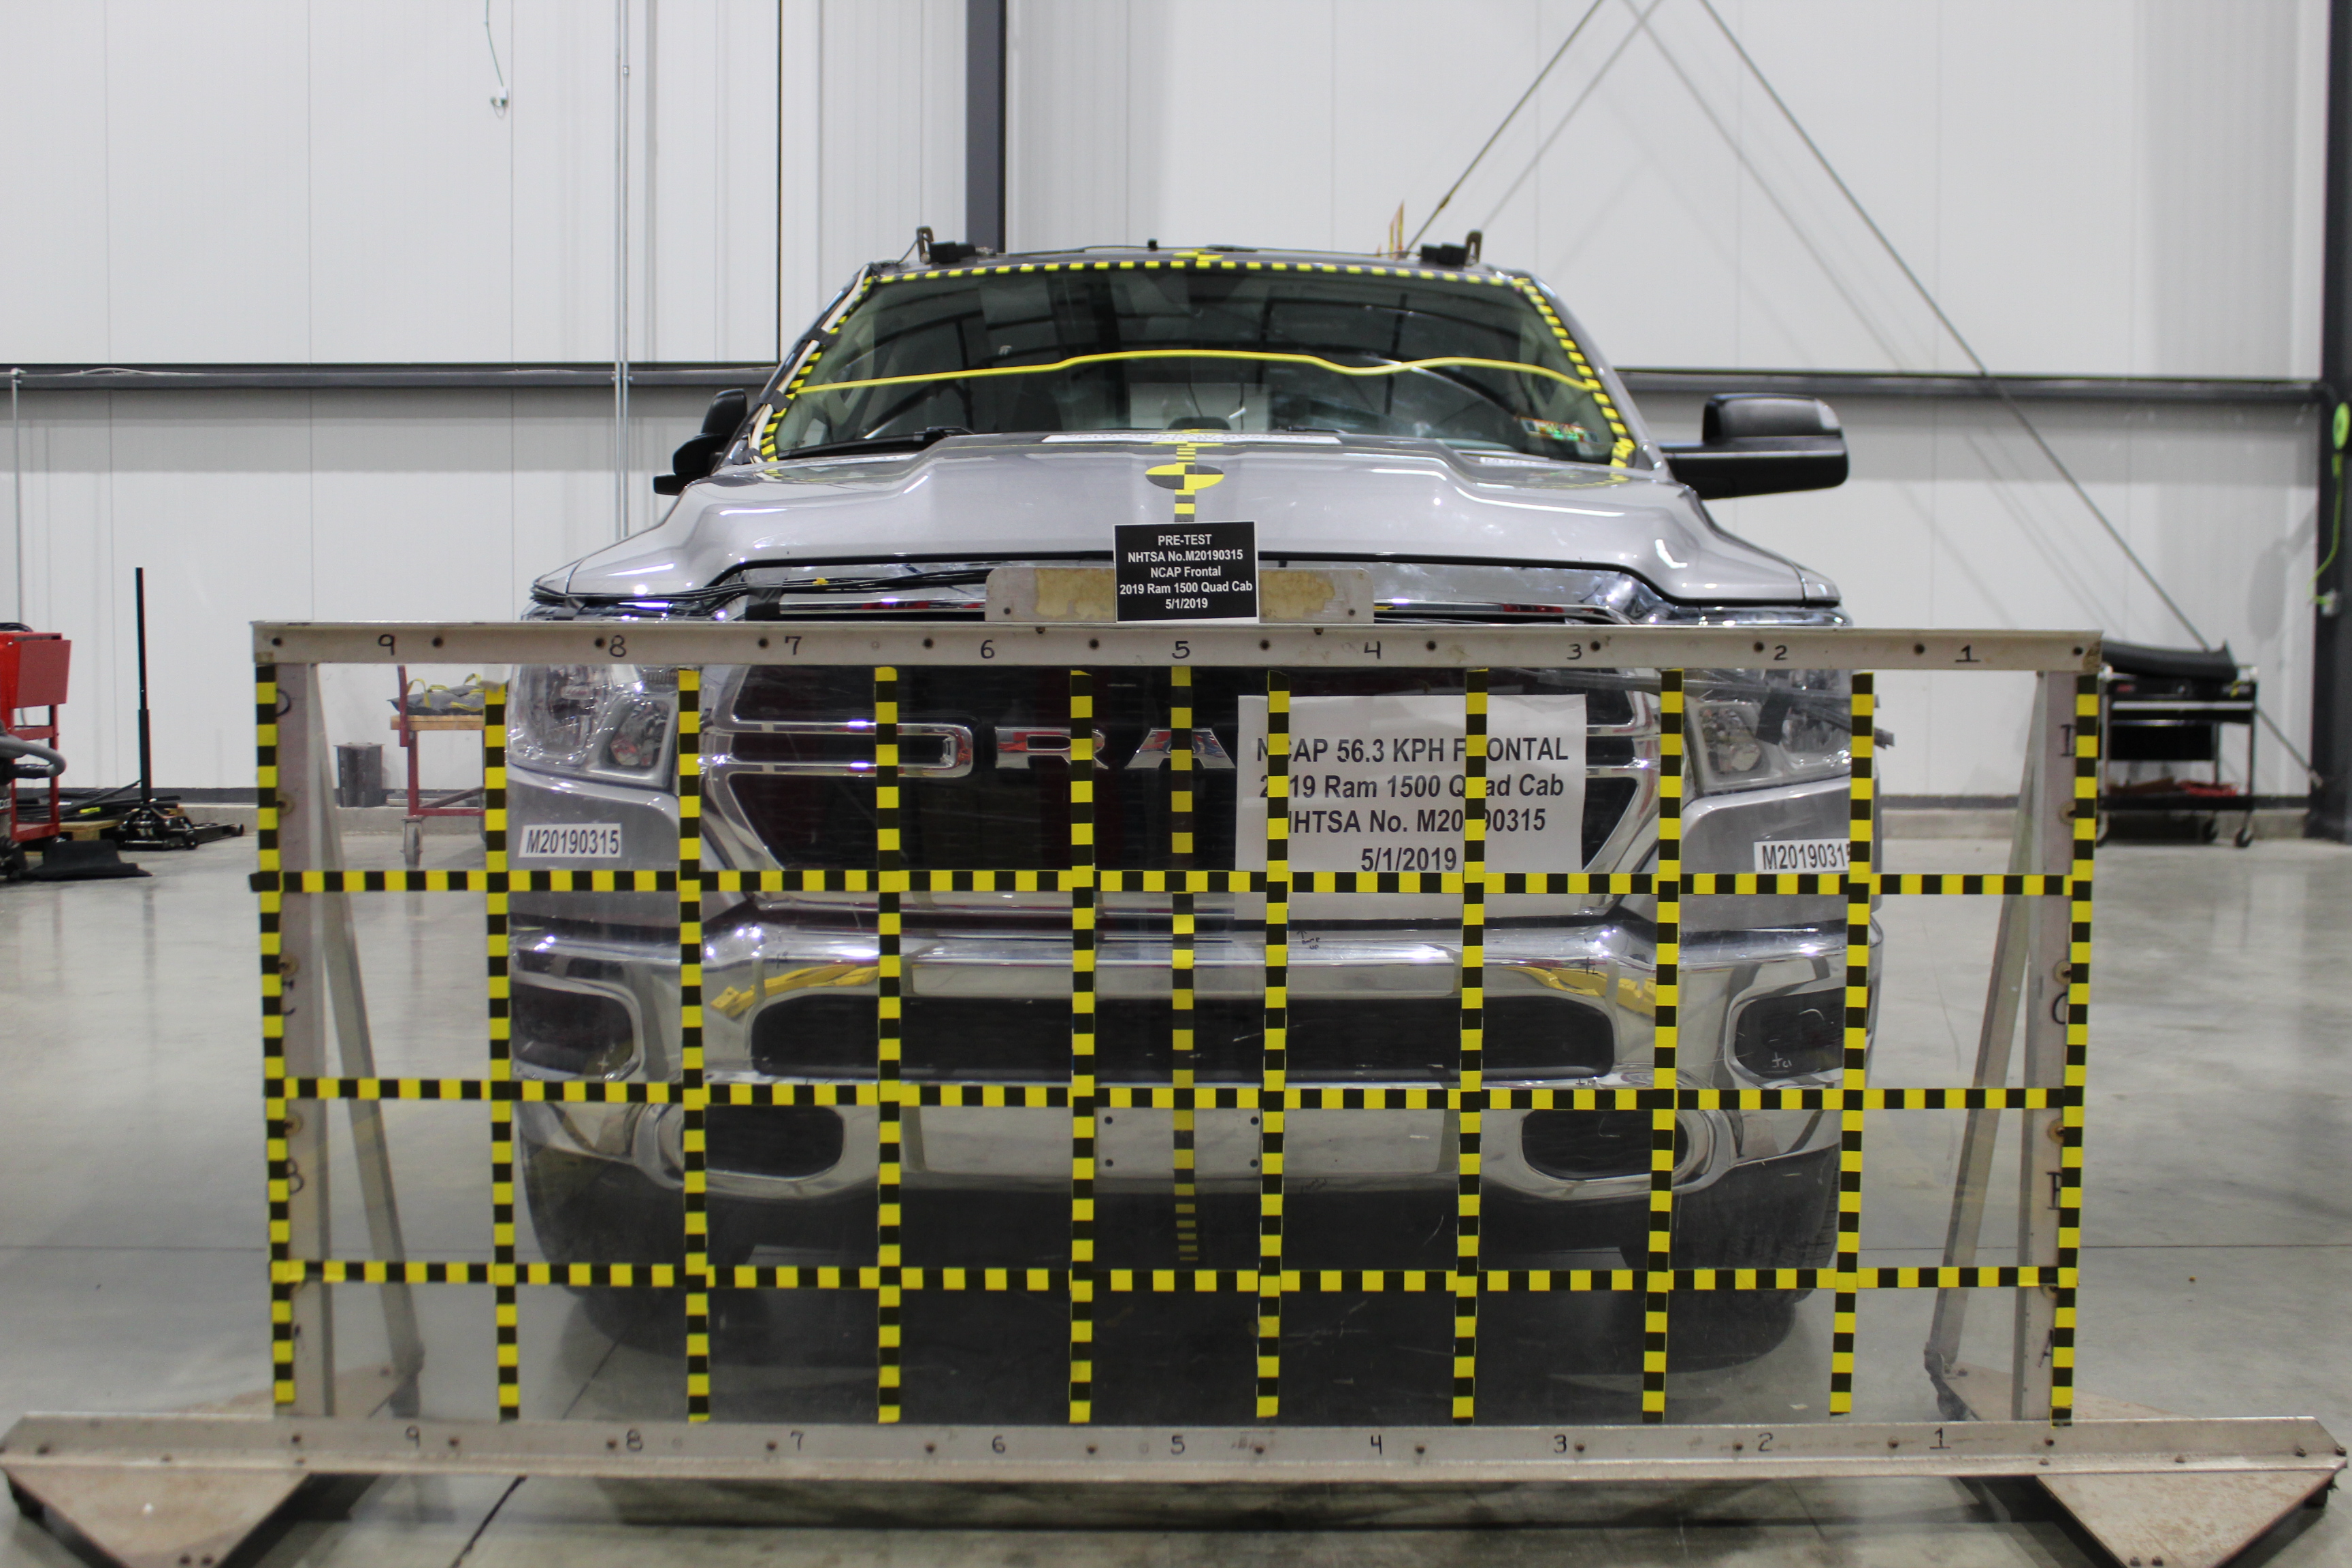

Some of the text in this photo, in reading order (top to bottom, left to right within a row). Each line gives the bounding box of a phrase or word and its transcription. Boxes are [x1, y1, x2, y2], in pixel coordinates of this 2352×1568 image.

[1158, 534, 1212, 546] PRE-TEST
[1127, 549, 1243, 563] NHTSA No.M20190315
[1150, 566, 1222, 578] NCAP Frontal
[1120, 580, 1253, 595] 2019 Ram 1500 Quad Cab
[1165, 598, 1209, 610] 5/1/2019
[378, 634, 1980, 664] 9 8 7 6 5 4 3 2 1
[1257, 737, 1569, 762] NAP 56.3 KPH FONTAL
[1260, 773, 1564, 798] 219 Ram 1500 Qad Cab
[1288, 808, 1546, 833] HTSA No. M2090315
[525, 830, 619, 855] M20190315
[1361, 847, 1456, 872] 5/1/2019
[404, 1426, 1951, 1455] 9 8 7 6 5 4 3 2 1
